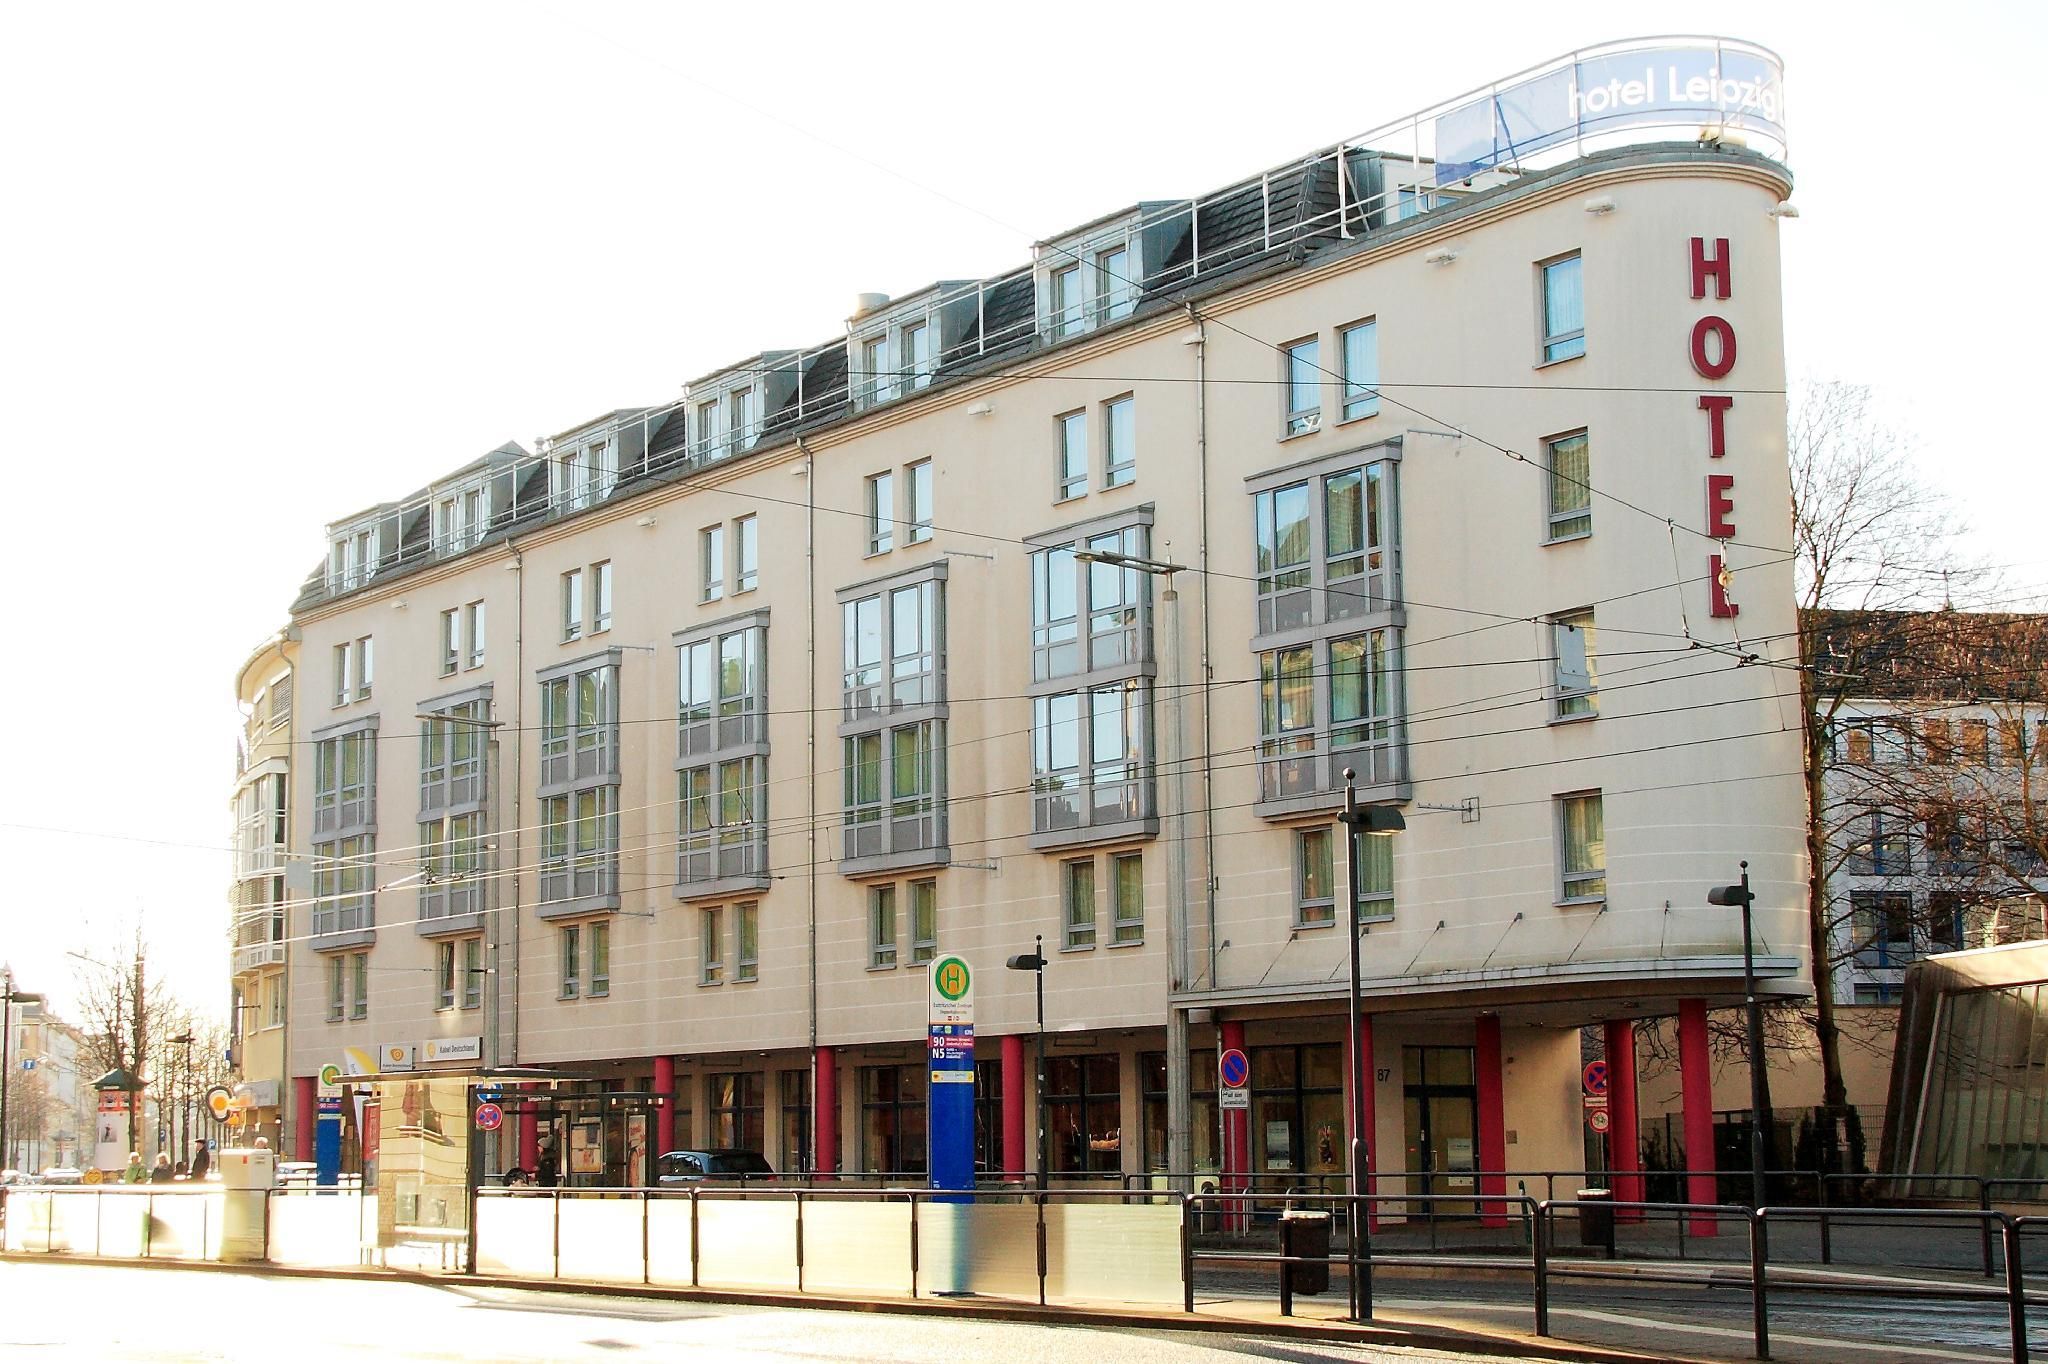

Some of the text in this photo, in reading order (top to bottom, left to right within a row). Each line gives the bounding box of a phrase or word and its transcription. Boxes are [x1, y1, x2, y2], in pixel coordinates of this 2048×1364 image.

[1568, 65, 1778, 121] hotel Leipzig
[1688, 236, 1739, 619] HOTEL
[933, 1036, 945, 1047] 90
[932, 1047, 945, 1059] N5
[1378, 1069, 1390, 1083] 87
